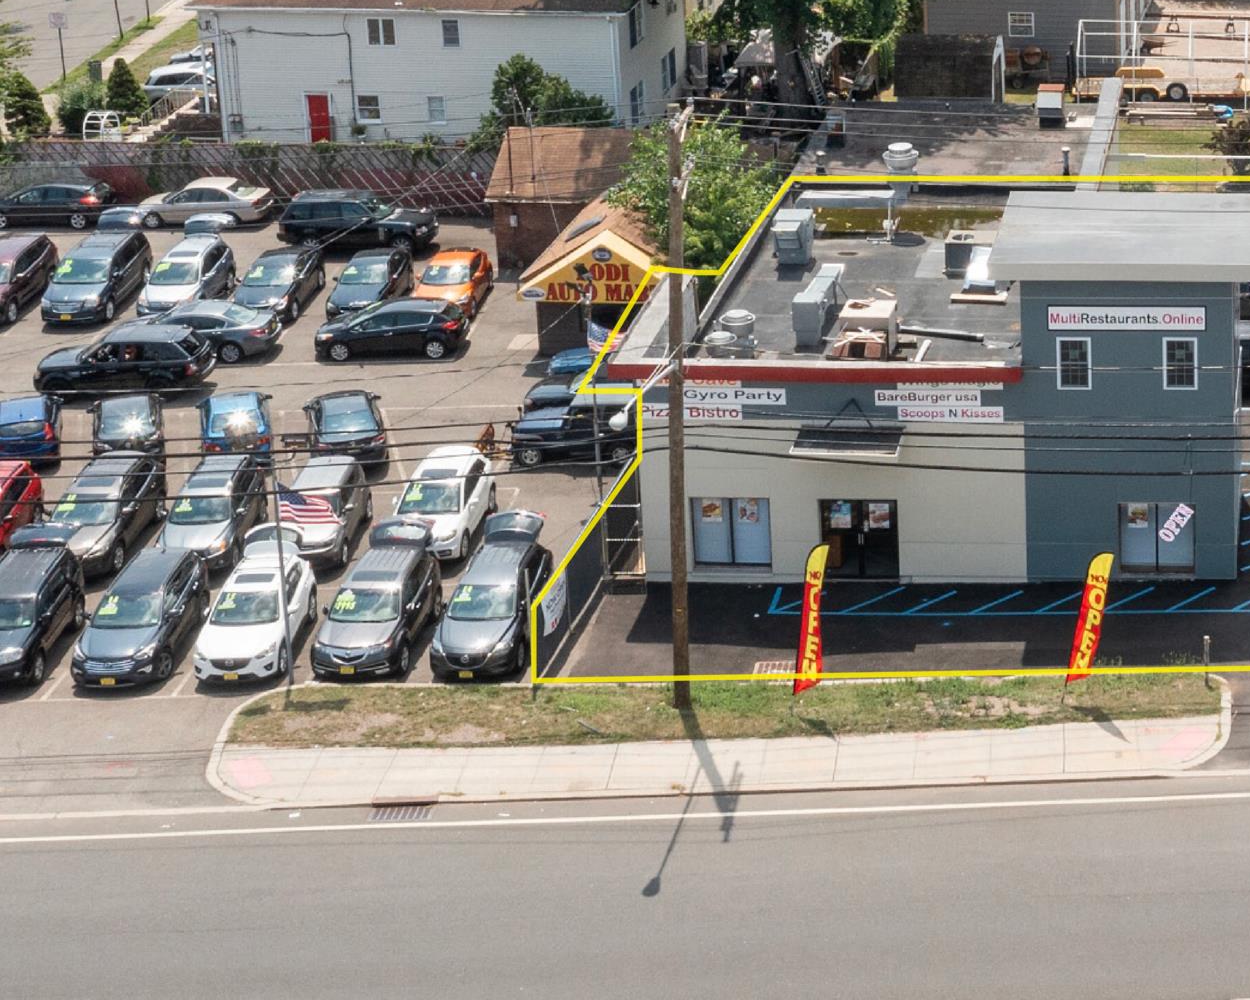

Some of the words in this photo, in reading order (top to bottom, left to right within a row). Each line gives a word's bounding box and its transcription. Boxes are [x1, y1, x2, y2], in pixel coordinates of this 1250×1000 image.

[576, 263, 629, 282] ODI
[603, 283, 657, 302] MAR
[1050, 312, 1204, 324] MultiRestaurants.Online
[684, 389, 728, 401] Gyro
[734, 389, 782, 402] Party
[877, 392, 952, 403] BareBurger
[955, 394, 978, 402] usa
[690, 406, 739, 418] Bistro
[900, 408, 945, 418] Scoops
[948, 409, 957, 418] N
[961, 409, 1001, 418] Kisses
[1158, 503, 1195, 542] OPEN
